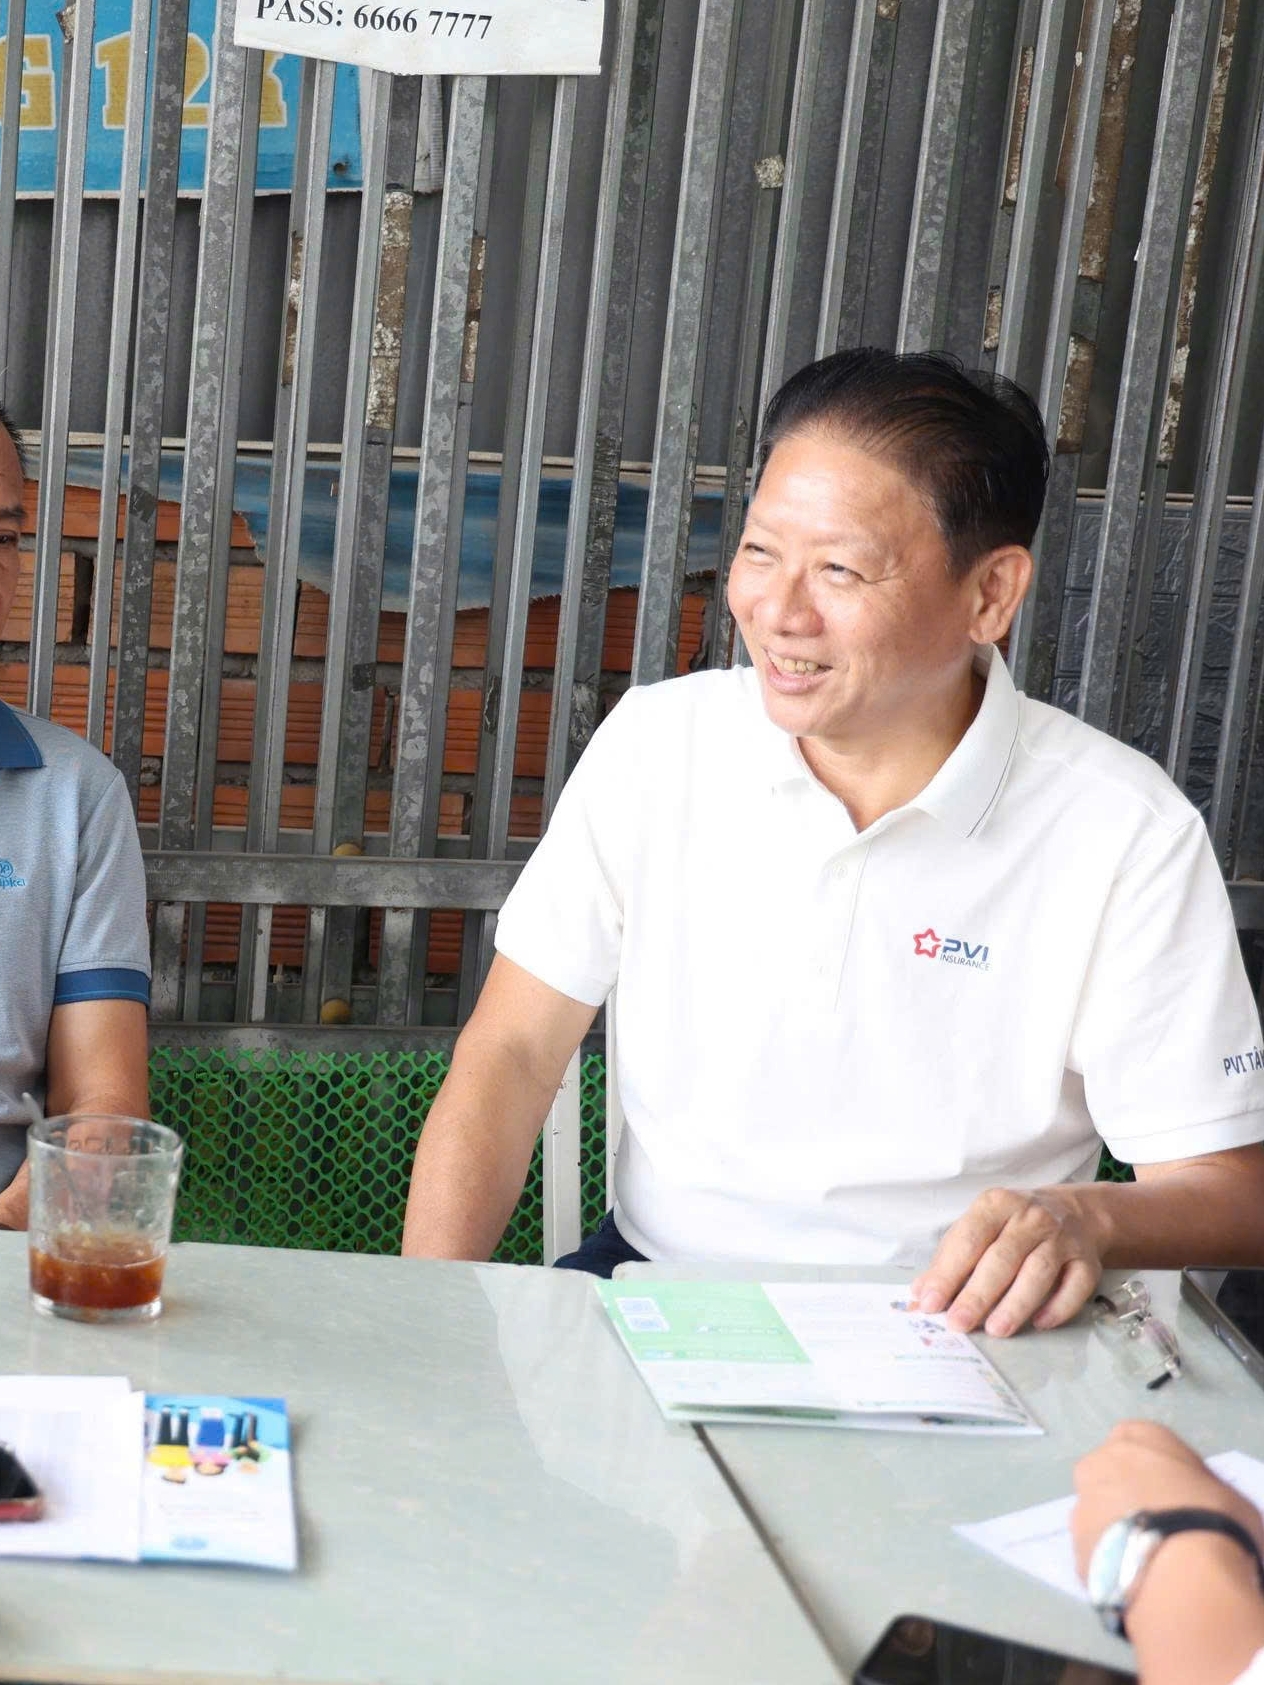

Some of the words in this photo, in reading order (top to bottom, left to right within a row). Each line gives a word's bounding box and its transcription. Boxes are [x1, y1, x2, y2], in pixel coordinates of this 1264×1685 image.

[256, 0, 343, 26] PASS:
[353, 4, 419, 33] 6666
[429, 10, 493, 40] 7777
[942, 938, 989, 962] PVI
[940, 953, 991, 971] INSURANCE
[1223, 1054, 1247, 1077] PVI
